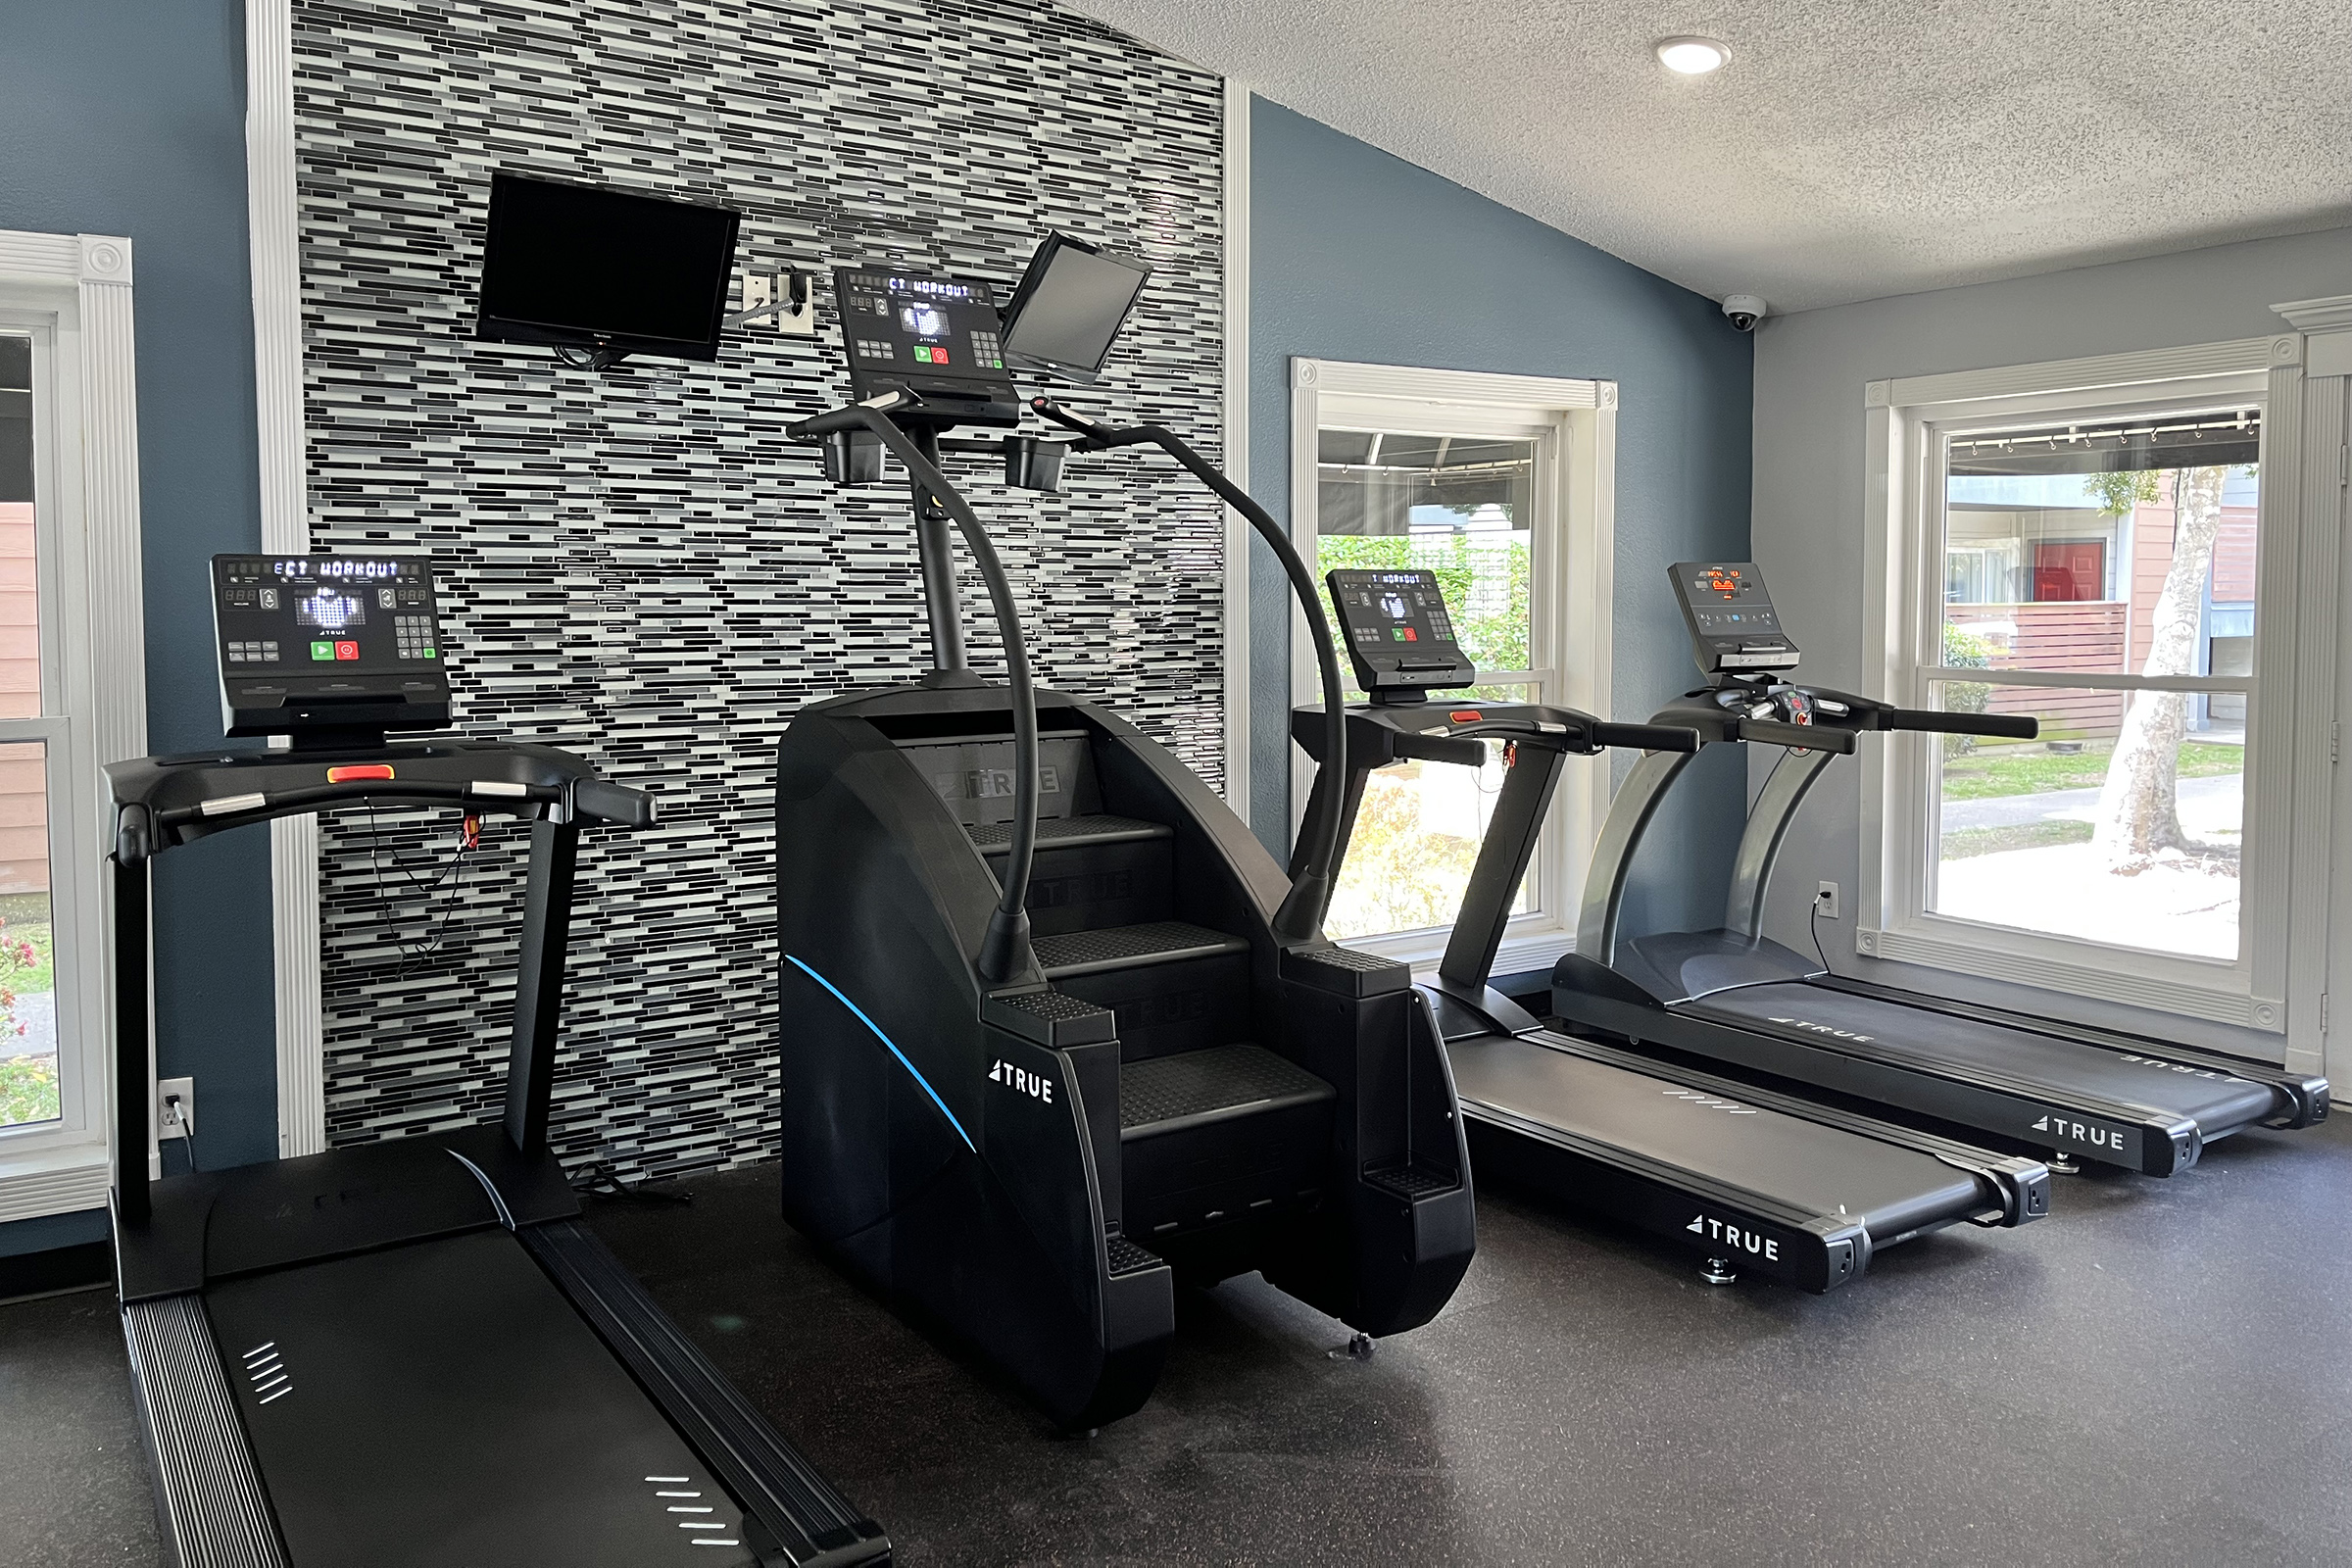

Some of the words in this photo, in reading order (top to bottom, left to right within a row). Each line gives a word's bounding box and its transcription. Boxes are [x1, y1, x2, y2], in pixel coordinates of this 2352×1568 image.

[913, 280, 968, 296] WORKOUT
[319, 561, 398, 577] WORKOUT
[1383, 574, 1419, 583] WORKOUT
[968, 770, 1056, 796] TRE
[1796, 1021, 1874, 1042] TRUE
[2120, 1054, 2217, 1080] TRUE
[1003, 1062, 1053, 1104] TRUE
[2053, 1118, 2124, 1151] TRUE
[1708, 1218, 1779, 1261] TRUE
